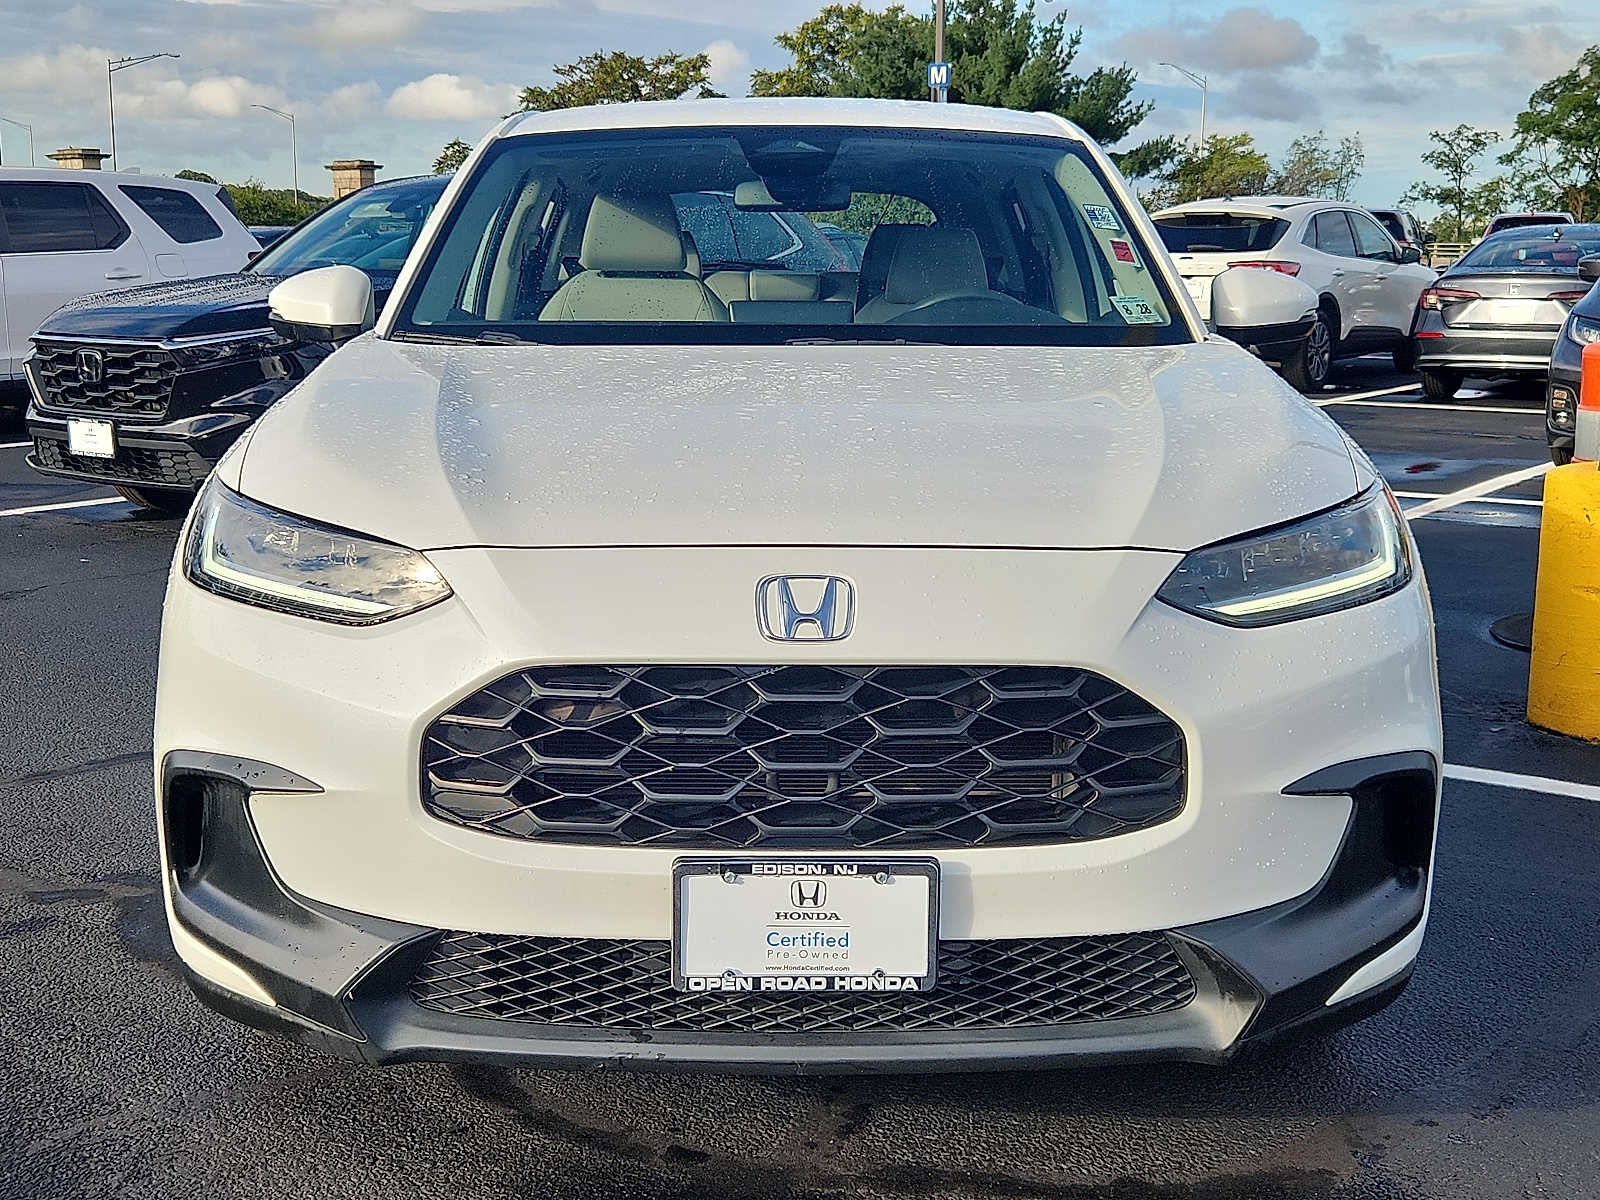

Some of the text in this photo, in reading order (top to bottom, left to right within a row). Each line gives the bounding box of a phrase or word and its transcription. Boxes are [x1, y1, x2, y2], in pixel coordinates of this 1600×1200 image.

[930, 65, 947, 85] M
[1122, 303, 1152, 315] 8 28
[751, 864, 858, 875] EDISON, NJ
[774, 911, 842, 921] HONDA
[766, 931, 849, 948] Certified
[767, 949, 849, 960] Pre-Owned
[688, 976, 919, 991] OPEN ROAD HONDA
